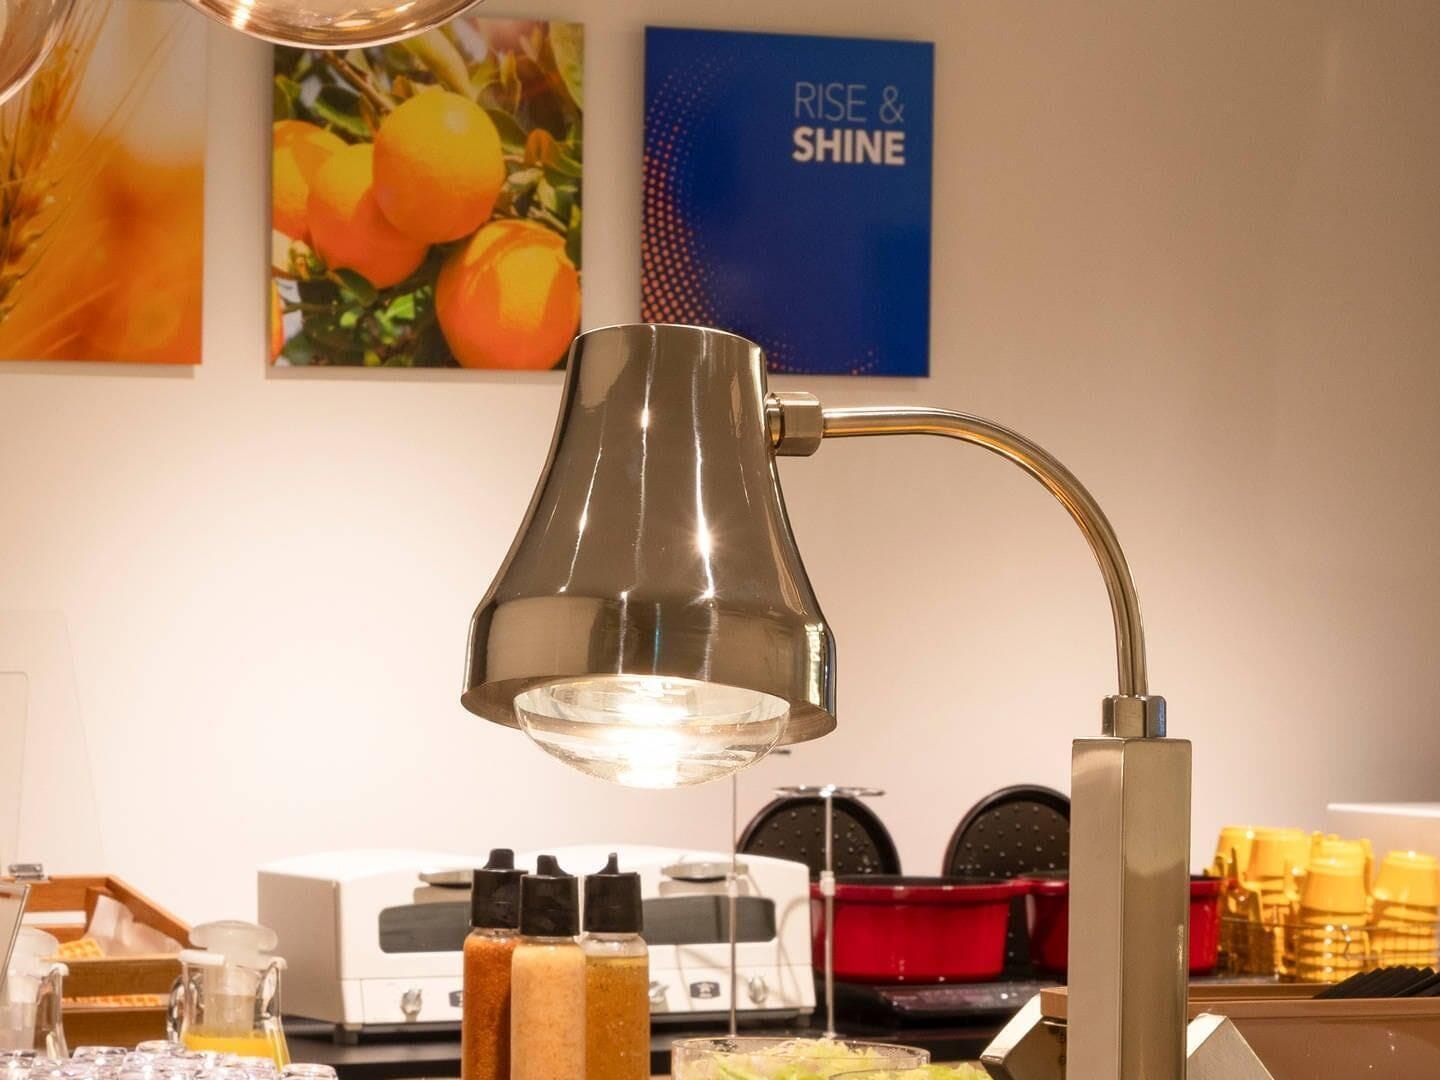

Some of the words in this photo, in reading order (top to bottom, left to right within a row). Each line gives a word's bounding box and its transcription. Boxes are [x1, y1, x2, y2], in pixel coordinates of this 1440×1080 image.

[794, 81, 867, 122] RISE
[879, 85, 905, 124] &
[792, 125, 906, 165] SHINE
